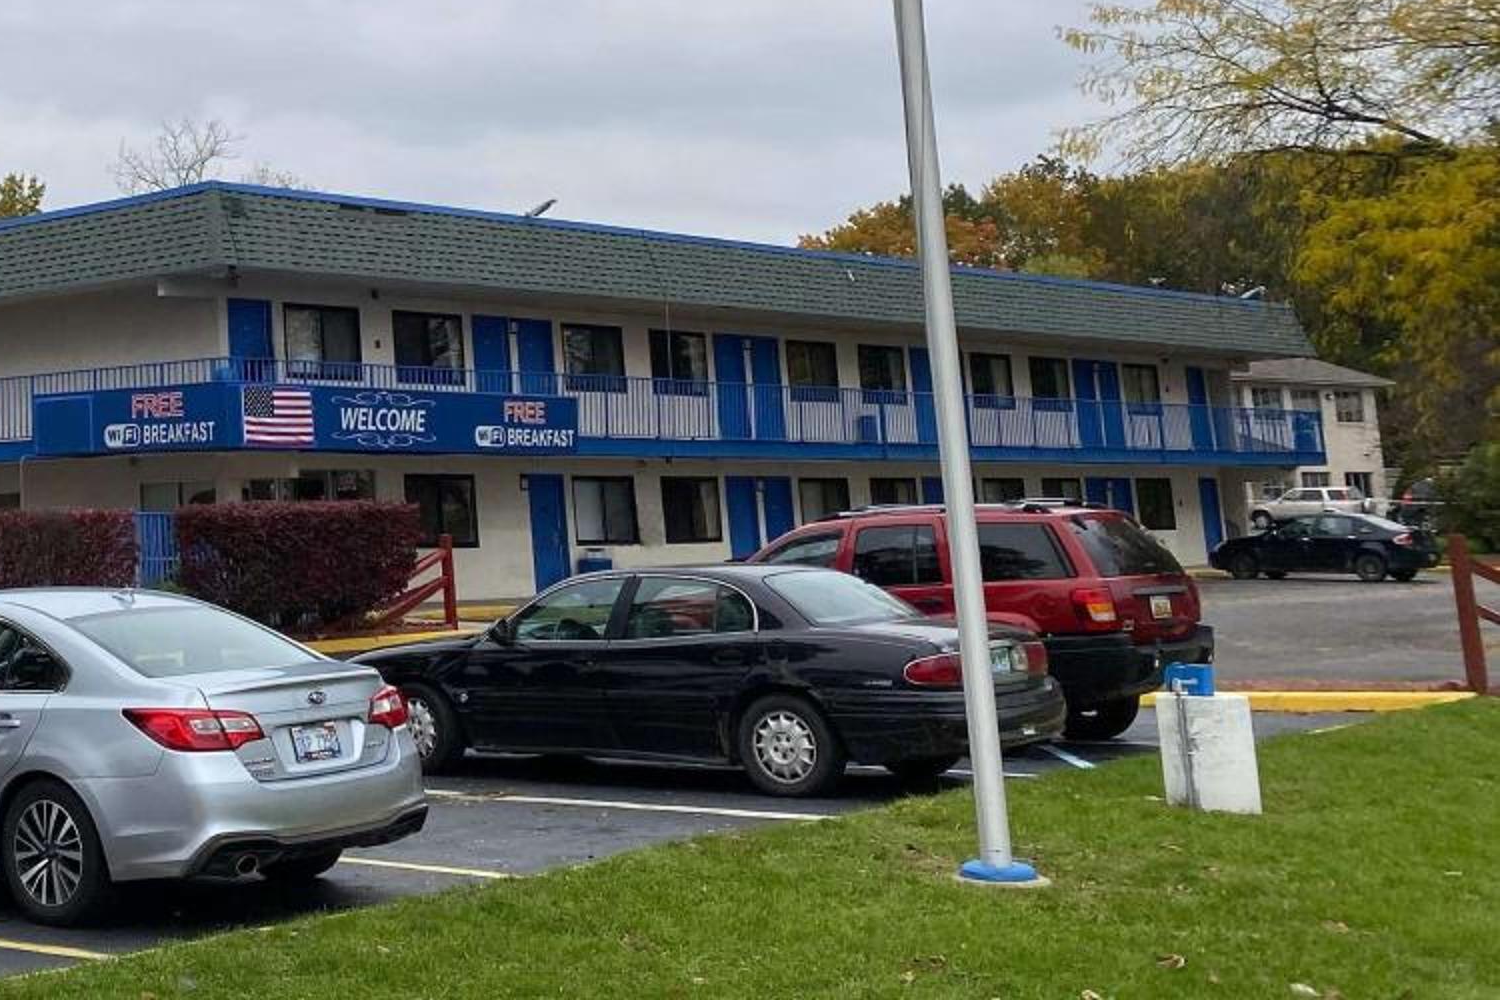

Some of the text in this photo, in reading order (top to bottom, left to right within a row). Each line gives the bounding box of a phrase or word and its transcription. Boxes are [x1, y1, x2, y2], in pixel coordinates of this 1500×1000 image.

[132, 392, 183, 418] FREE
[504, 401, 546, 424] FREE
[341, 407, 426, 432] WELCOME
[143, 421, 215, 444] BREAKFAST
[507, 427, 574, 446] BREAKFAST
